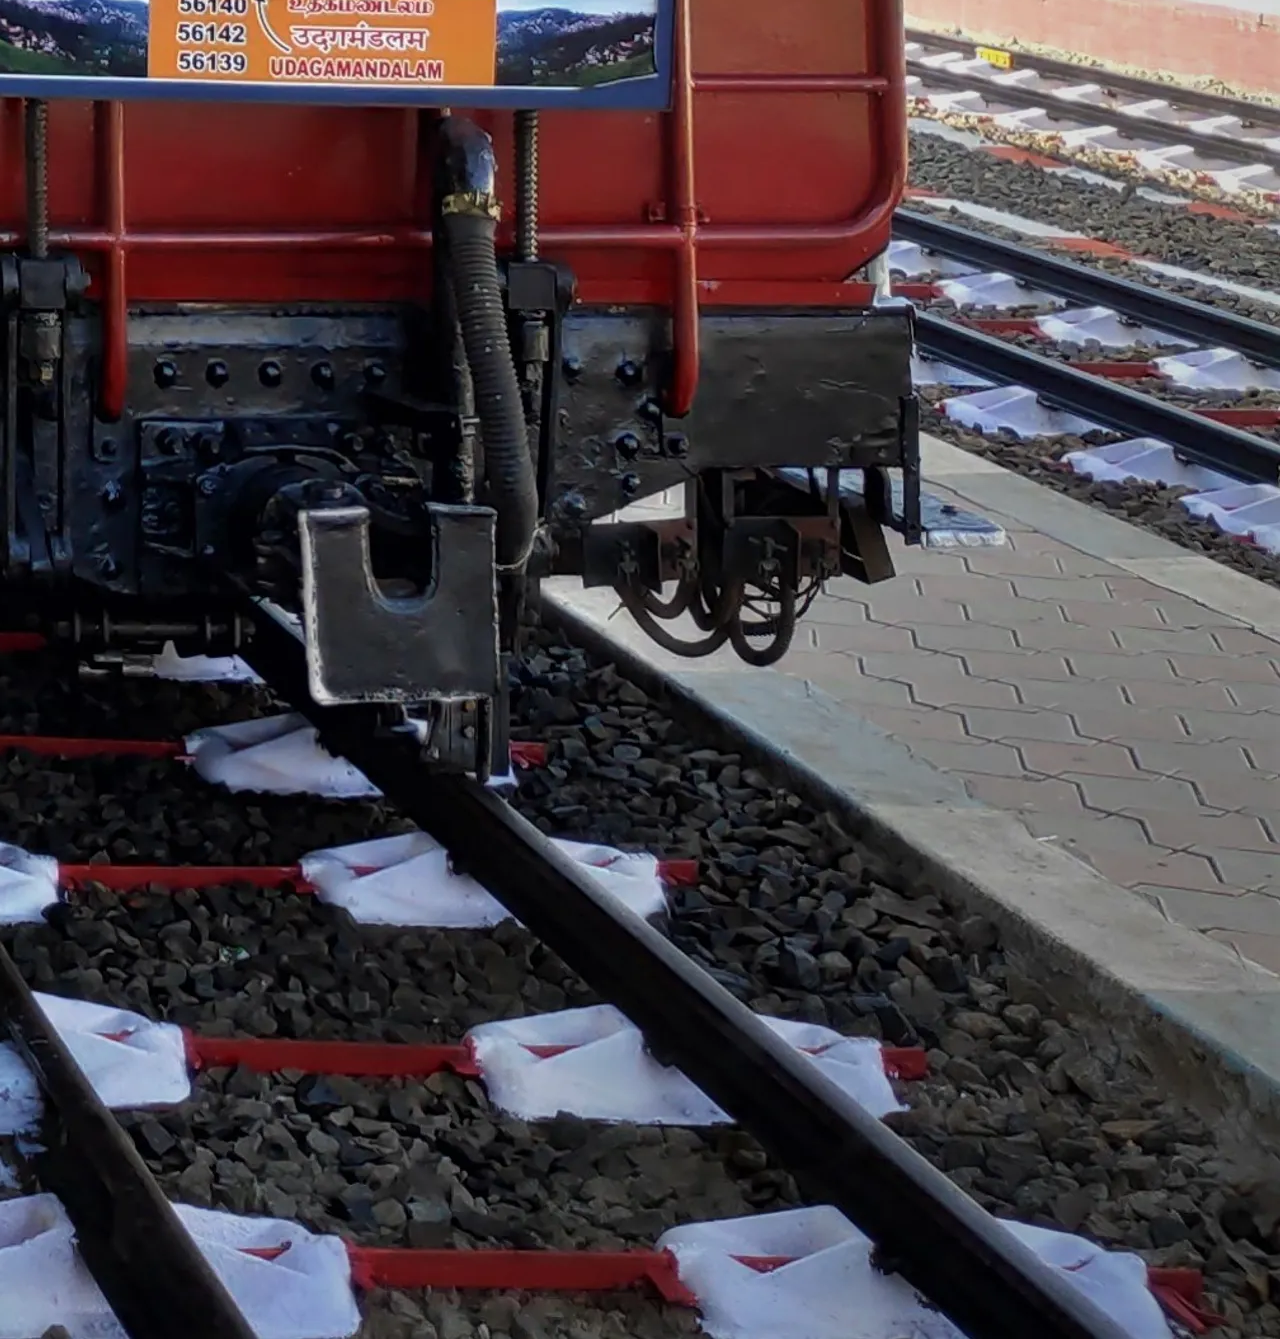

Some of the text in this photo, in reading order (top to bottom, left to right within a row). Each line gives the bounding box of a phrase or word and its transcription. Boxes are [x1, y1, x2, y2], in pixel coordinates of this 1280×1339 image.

[177, 23, 245, 43] 56142
[291, 22, 428, 51] उदगमंडलम
[178, 52, 246, 72] 56139
[271, 58, 442, 79] UDAGAMANDALAM
